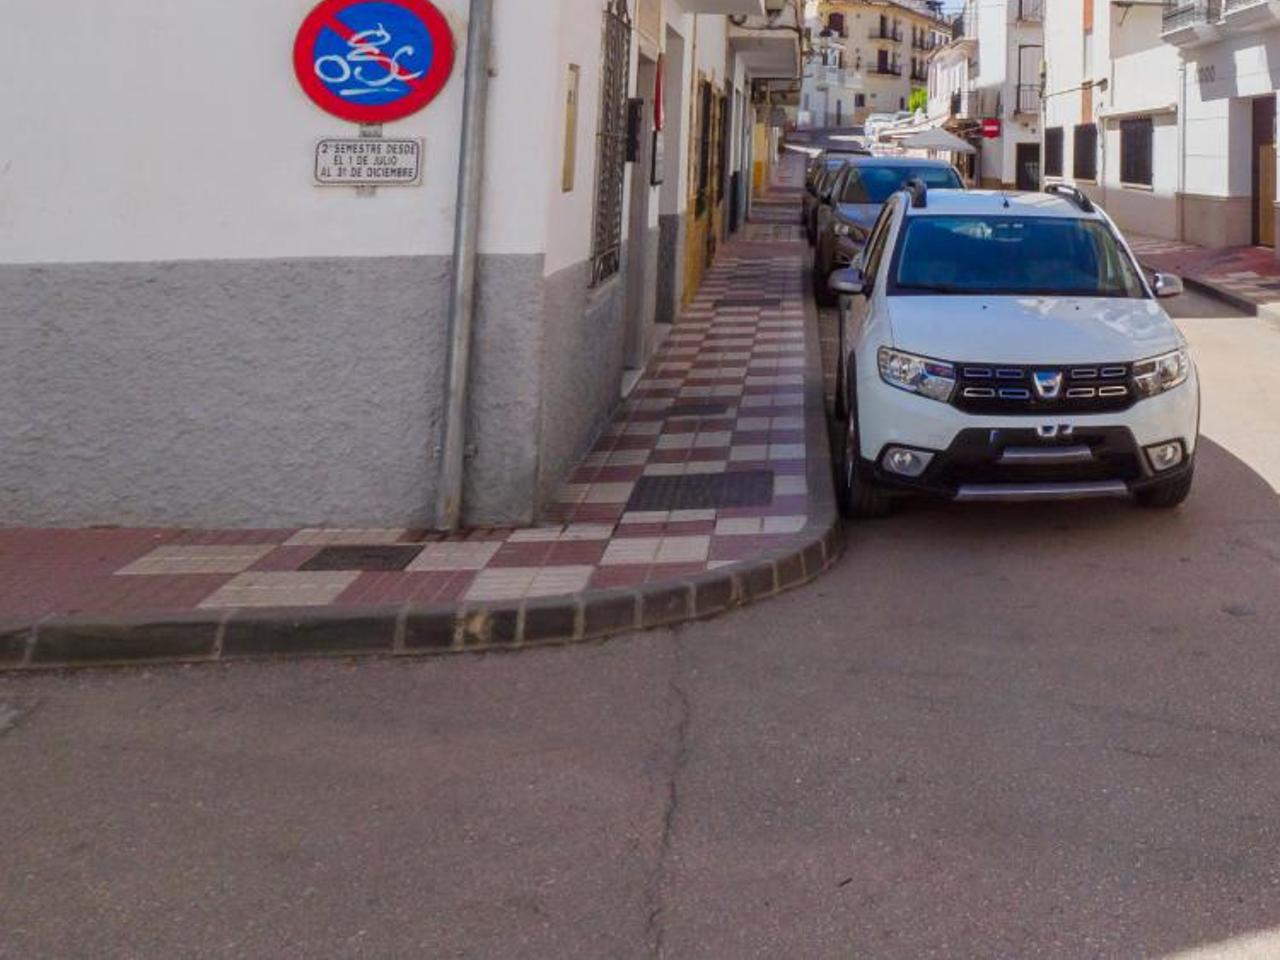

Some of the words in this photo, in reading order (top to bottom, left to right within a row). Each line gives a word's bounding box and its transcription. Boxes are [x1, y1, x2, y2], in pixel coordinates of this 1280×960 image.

[335, 143, 381, 154] SEMESTRE
[386, 143, 415, 155] DESDE
[334, 155, 343, 166] EL
[356, 155, 368, 166] DE
[373, 155, 398, 166] JULIO
[321, 167, 332, 177] AL
[351, 167, 361, 178] DE
[366, 167, 414, 178] DICIEMBRE
